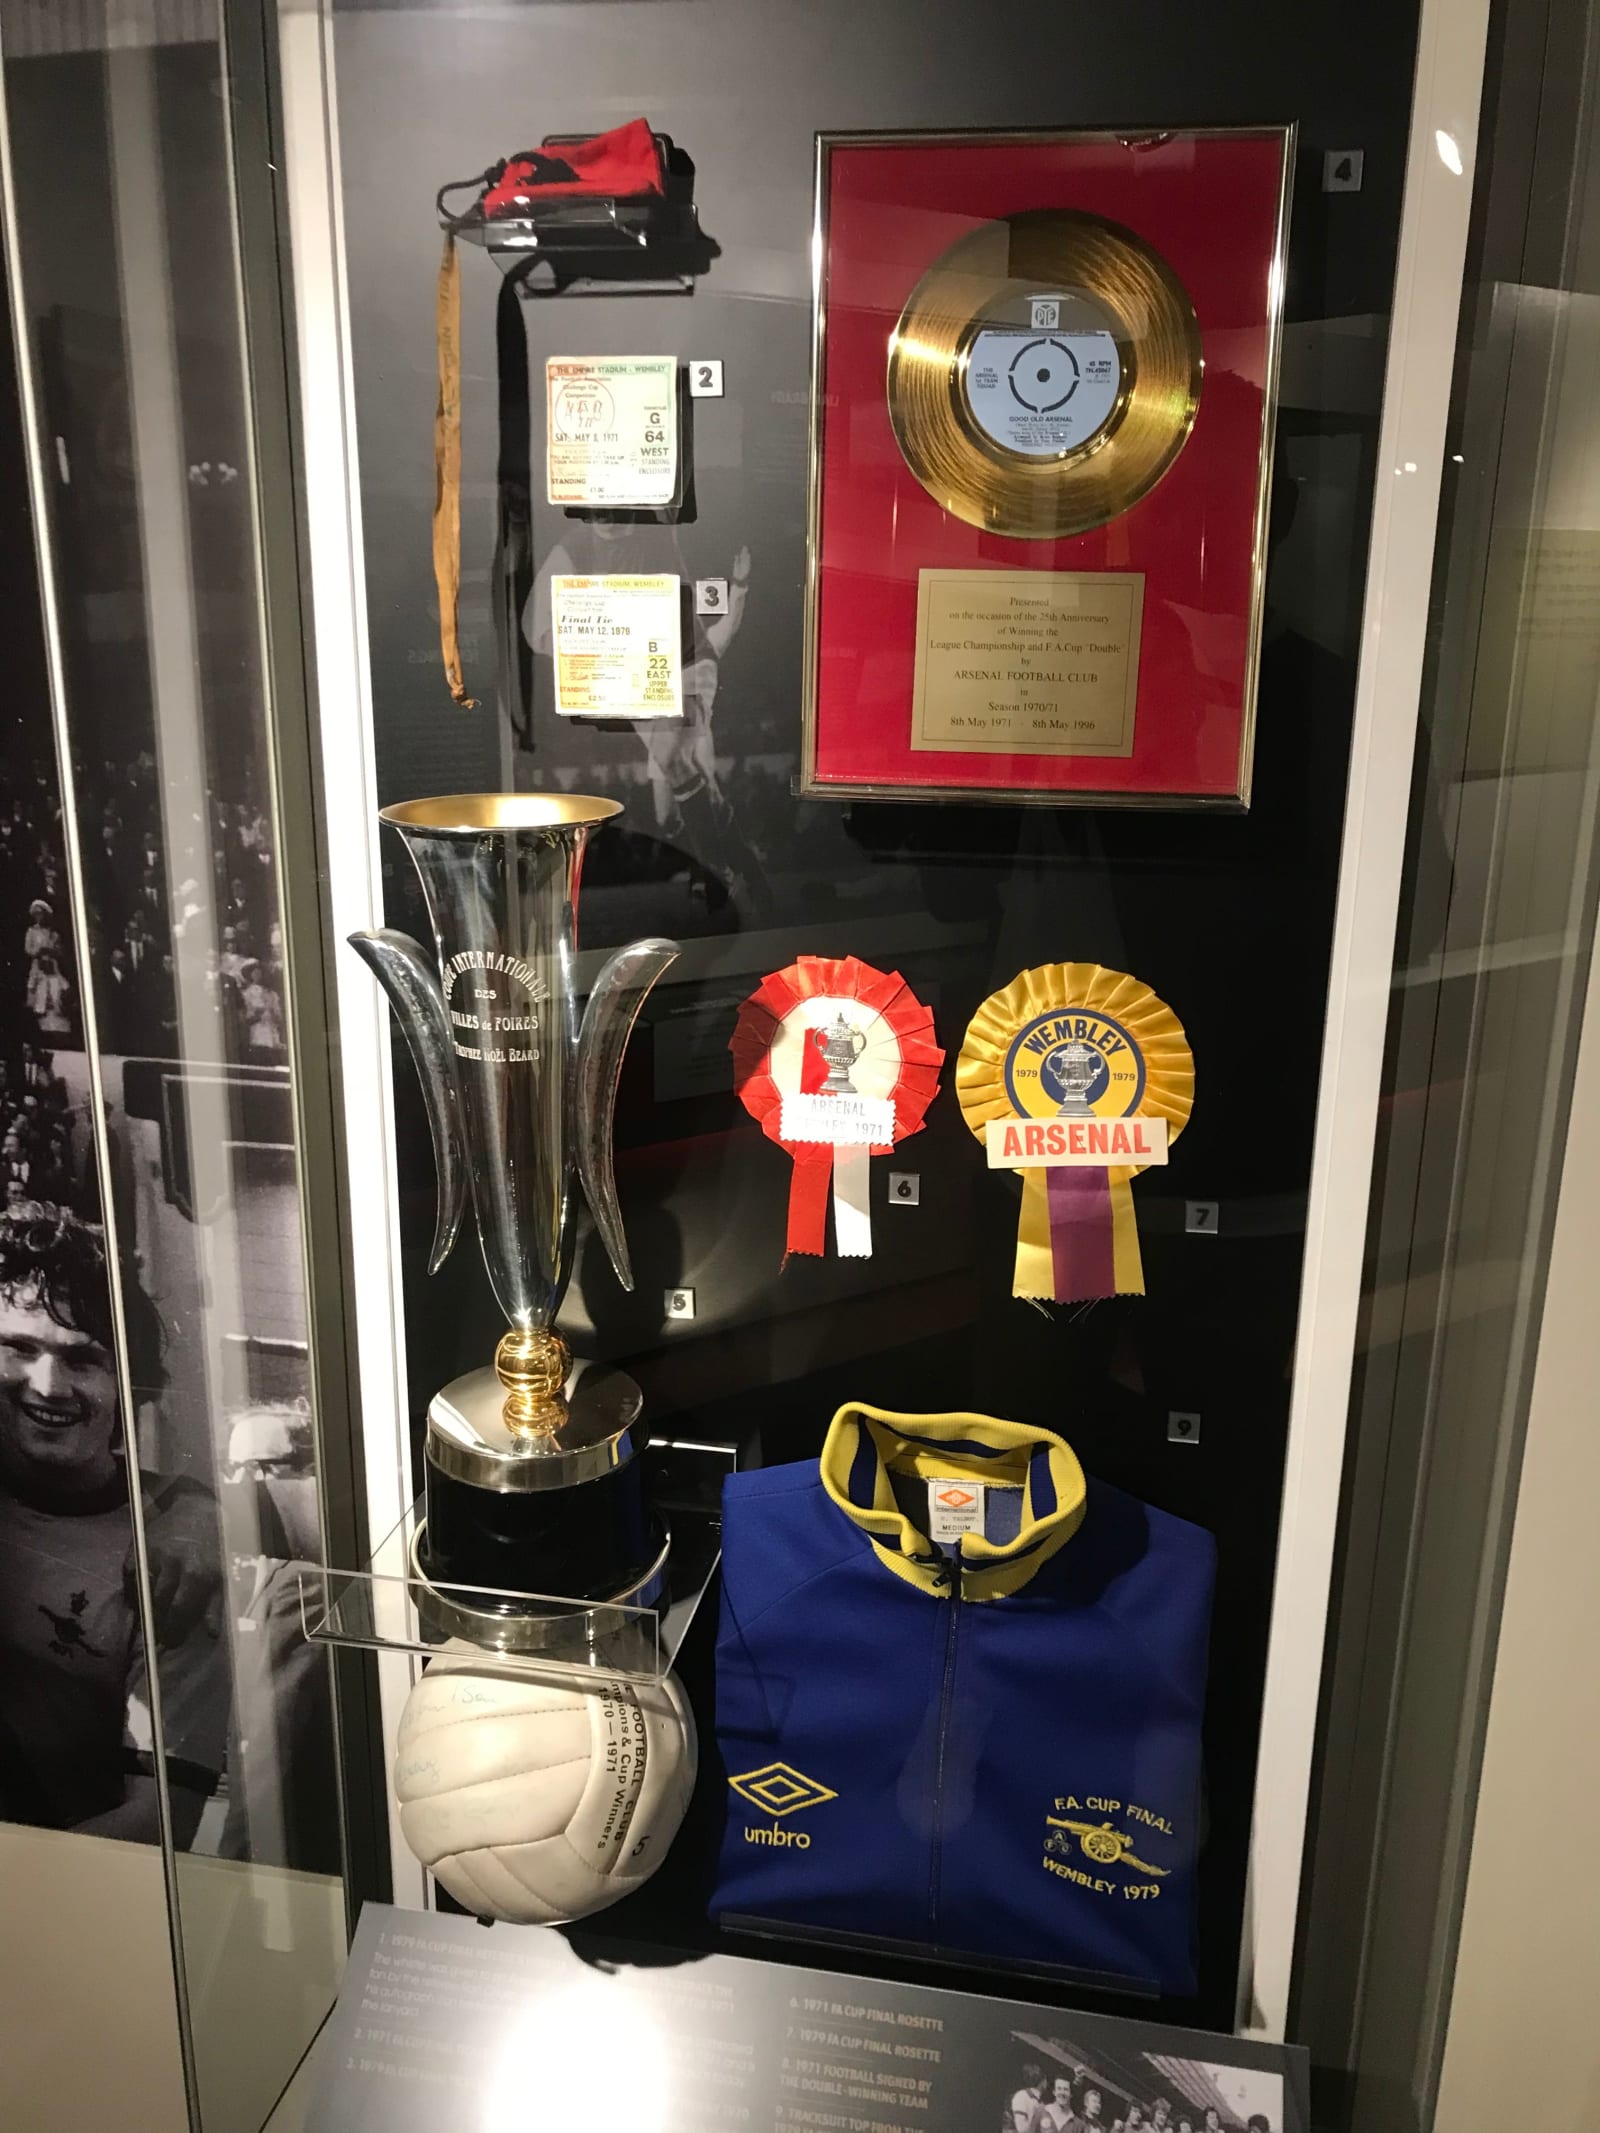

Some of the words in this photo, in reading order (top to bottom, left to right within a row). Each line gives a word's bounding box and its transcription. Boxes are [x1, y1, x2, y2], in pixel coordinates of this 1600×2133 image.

[1334, 158, 1352, 181] 4
[598, 366, 627, 374] STADIUM
[635, 365, 665, 373] WEMBLEY
[699, 367, 713, 388] 2
[650, 413, 661, 424] G
[574, 432, 590, 441] MAY
[645, 430, 664, 442] 64
[641, 448, 669, 456] WEST
[634, 580, 664, 588] WEMBLEY
[704, 586, 719, 607] 3
[1009, 597, 1050, 607] Presented
[561, 615, 592, 624] Final
[961, 611, 974, 620] the
[976, 612, 1012, 621] occasion
[1013, 611, 1023, 621] of
[1024, 612, 1037, 621] the
[1040, 613, 1058, 622] 25th
[1060, 613, 1110, 624] Anniversary
[577, 626, 594, 635] MAY
[997, 627, 1007, 636] of
[1009, 627, 1044, 638] Winning
[1046, 628, 1059, 637] the
[649, 642, 658, 652] B
[930, 639, 961, 651] League
[963, 640, 1026, 653] Championship
[1028, 642, 1043, 652] and
[649, 658, 668, 669] 22
[1021, 657, 1031, 667] by
[647, 671, 671, 679] EAST
[953, 671, 1002, 680] ARSENAL
[1007, 672, 1064, 682] FOOTBALL
[1067, 673, 1098, 683] CLUB
[1020, 688, 1028, 697] in
[988, 701, 1020, 712] Season
[1023, 702, 1058, 713] 1970/71
[950, 717, 965, 727] 8th
[967, 717, 987, 729] May
[991, 718, 1011, 728] 1971
[1032, 719, 1047, 729] 8th
[1049, 719, 1070, 731] May
[1074, 720, 1095, 730] 1996
[451, 950, 551, 1003] INTERNATIONALE
[474, 989, 497, 999] DES
[450, 1010, 479, 1029] VILLES
[482, 1020, 492, 1031] de
[1023, 1019, 1127, 1056] WEMBLEY
[1016, 1070, 1038, 1078] 1979
[1113, 1073, 1135, 1081] 1979
[811, 1099, 866, 1116] ARSENAL
[856, 1122, 883, 1136] 1971
[1003, 1124, 1151, 1157] ARSENAL
[897, 1180, 911, 1197] 6
[1196, 1208, 1210, 1226] 7
[673, 1294, 686, 1311] 5
[1177, 1419, 1192, 1436] 9
[599, 1687, 614, 1718] 1970
[621, 1737, 631, 1747] &
[630, 1699, 647, 1787] FOOTBALL
[606, 1740, 617, 1773] 1971
[618, 1754, 631, 1784] Cup
[598, 1789, 626, 1849] Winners
[614, 1800, 634, 1841] CLUB
[1086, 1797, 1121, 1813] CUP
[1126, 1805, 1173, 1835] FINAL
[744, 1821, 811, 1849] umbro
[1043, 1856, 1116, 1895] WEMBLEY
[1123, 1884, 1160, 1900] 1979
[804, 1998, 829, 2013] 1971
[831, 2003, 843, 2015] FA
[844, 2005, 866, 2019] CUP
[866, 2009, 896, 2025] FINAL
[897, 2013, 944, 2032] ROSETTE
[799, 2029, 826, 2044] 1979
[827, 2033, 840, 2047] FA
[840, 2034, 863, 2050] CUP
[863, 2038, 892, 2056] FINAL
[894, 2044, 942, 2063] ROSETTE
[796, 2059, 820, 2075] 1971
[823, 2063, 875, 2086] FOOTBALL
[876, 2072, 917, 2092] SIGNED
[918, 2077, 933, 2094] BY
[780, 2074, 800, 2089] THE
[899, 2093, 929, 2110] TEAM
[789, 2107, 848, 2129] TRACKSUIT
[849, 2117, 870, 2132] TOP
[871, 2121, 903, 2133] FROM
